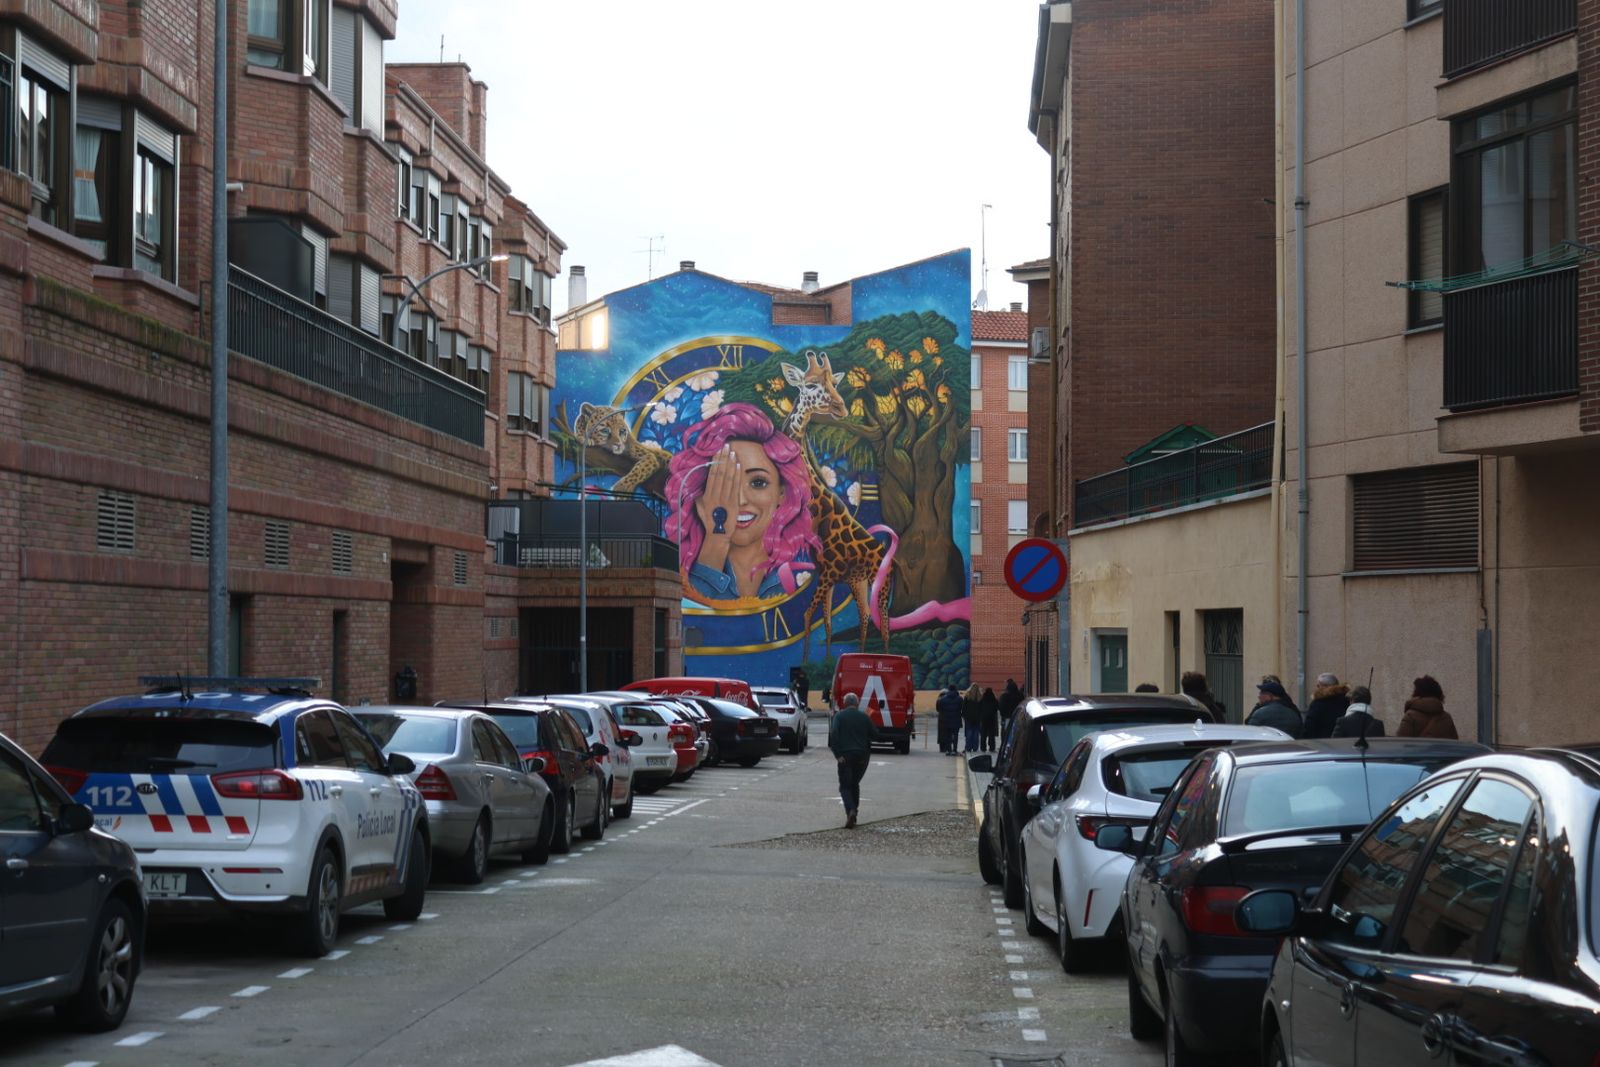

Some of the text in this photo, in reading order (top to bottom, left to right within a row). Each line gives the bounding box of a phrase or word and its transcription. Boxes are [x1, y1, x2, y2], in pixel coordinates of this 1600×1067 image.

[716, 343, 743, 368] XII
[643, 367, 672, 386] XI
[86, 786, 132, 806] 112
[305, 779, 329, 801] 112
[380, 809, 396, 835] Local
[150, 874, 181, 890] KLT
